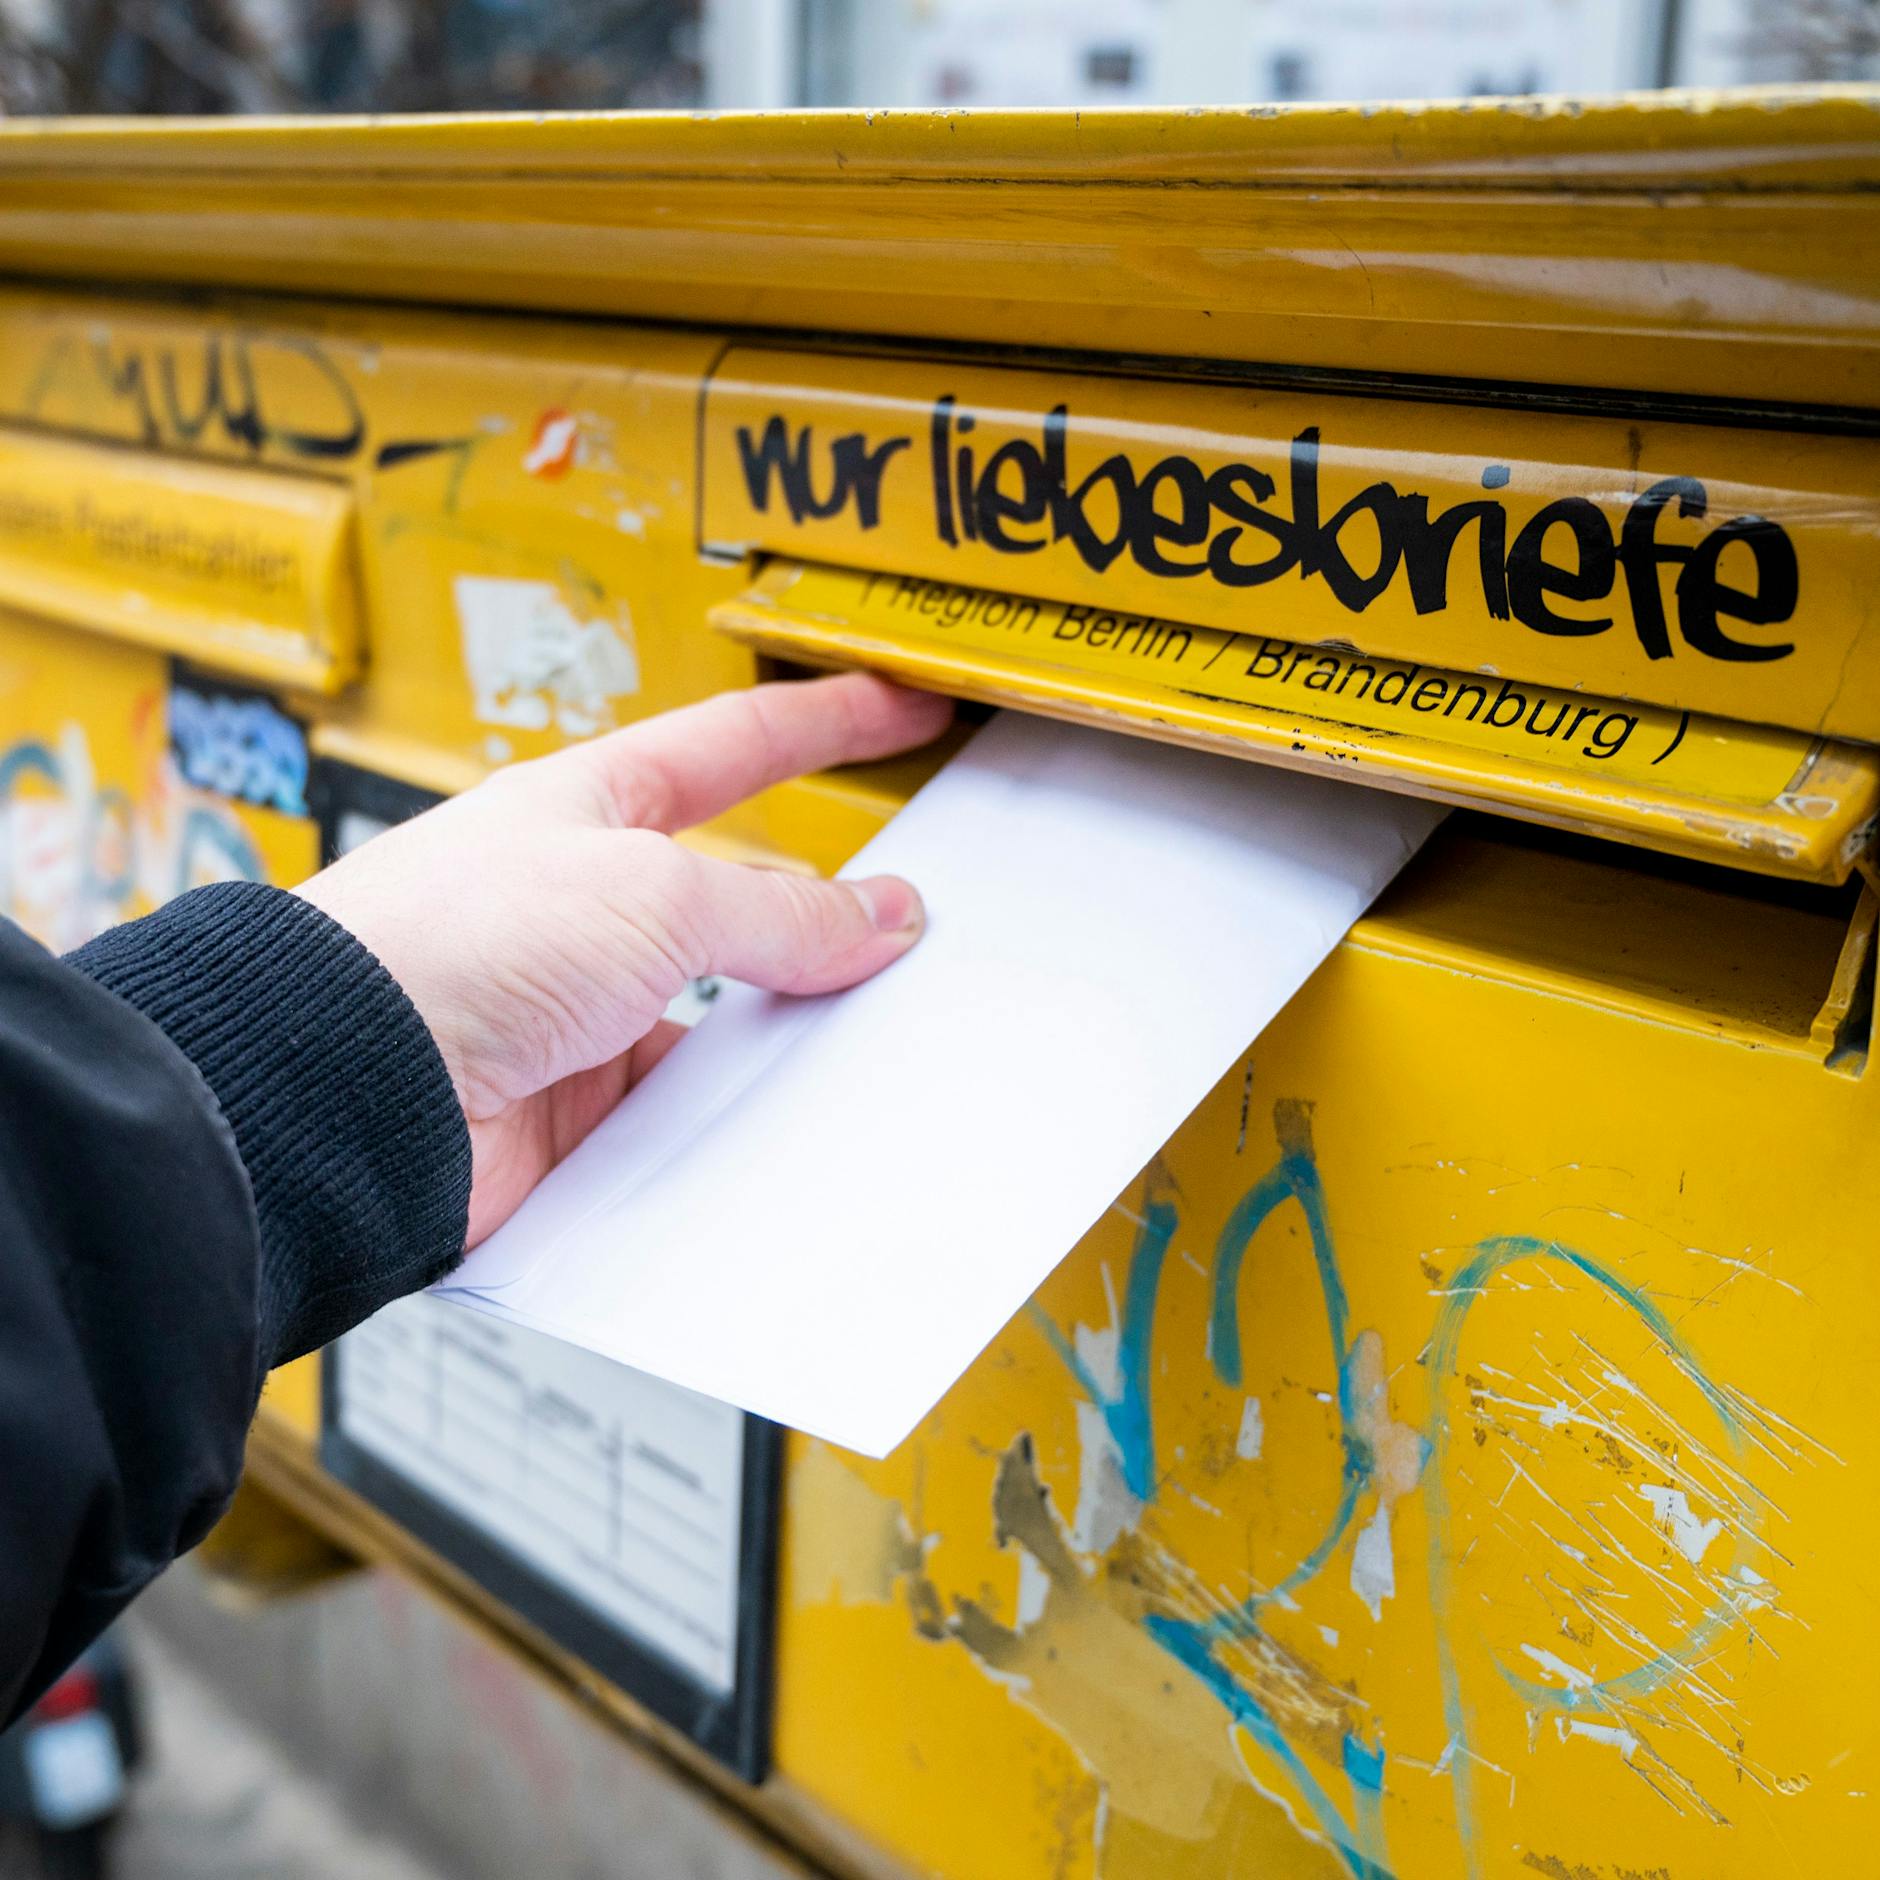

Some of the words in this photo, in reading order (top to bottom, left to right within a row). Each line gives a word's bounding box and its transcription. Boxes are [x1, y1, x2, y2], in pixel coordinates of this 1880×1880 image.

[735, 414, 912, 531] nur
[931, 394, 1799, 662] liebesbriefe
[888, 577, 1041, 634] Region
[1053, 604, 1193, 663] Berlin
[1202, 632, 1241, 671] /
[1245, 638, 1639, 760] Brandenburg
[1650, 711, 1691, 766] )
